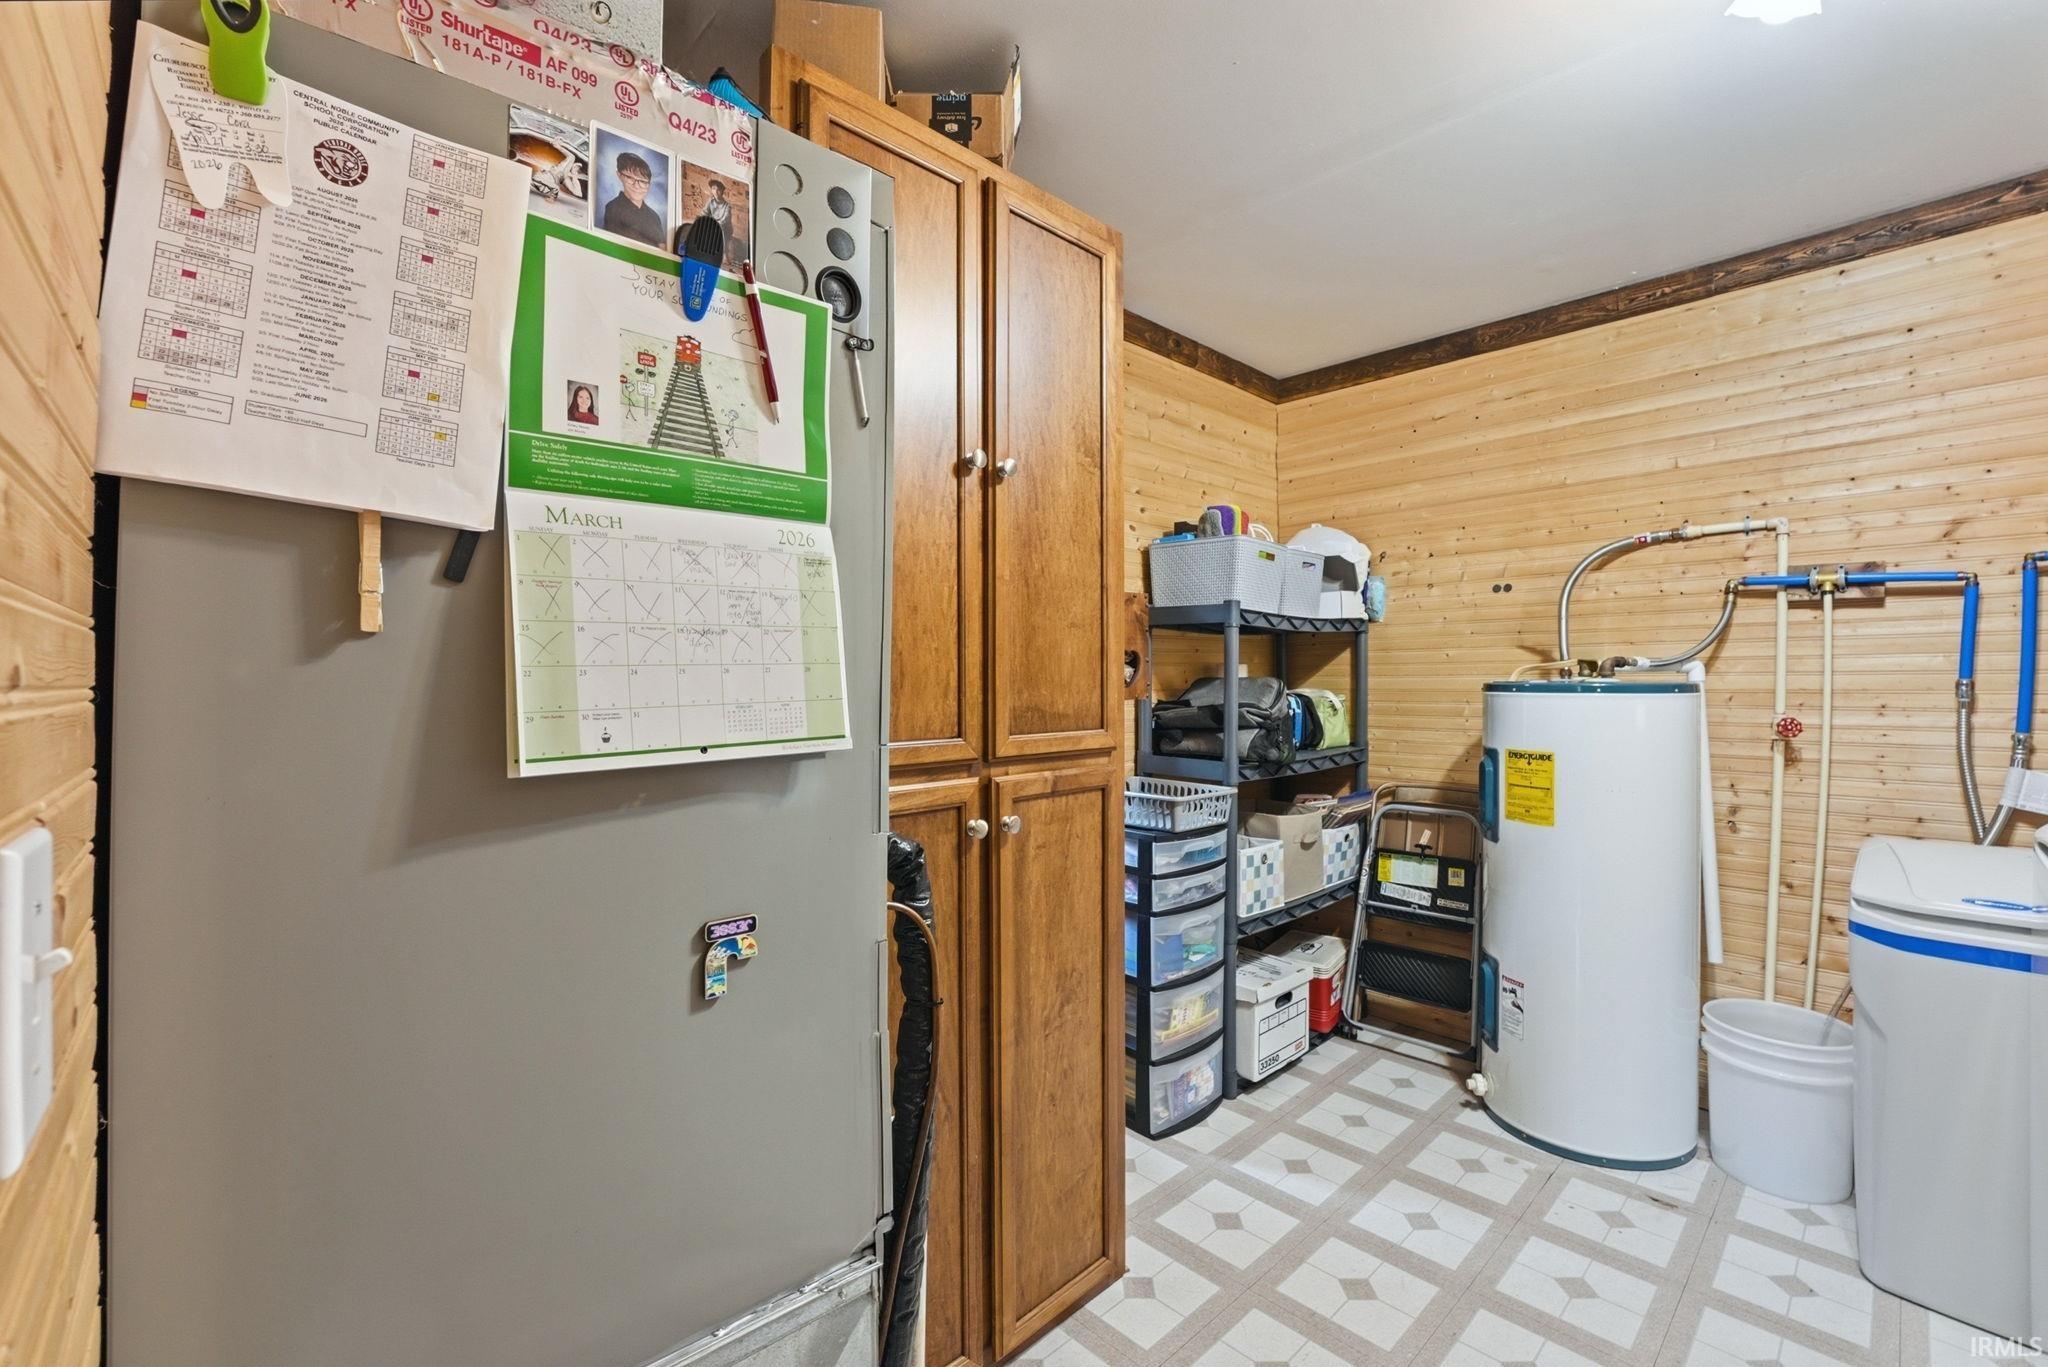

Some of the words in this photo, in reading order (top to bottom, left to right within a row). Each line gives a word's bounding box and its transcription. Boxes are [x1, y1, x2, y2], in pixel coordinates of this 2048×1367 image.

[401, 16, 432, 34] LISTED
[441, 11, 524, 56] Shurtape
[546, 57, 567, 73] AF
[572, 67, 597, 87] 099
[442, 35, 500, 65] 181A-P
[506, 61, 512, 70] /
[518, 65, 581, 99] 181B-FX
[621, 89, 633, 102] UL
[293, 90, 328, 108] CENTRAL
[330, 105, 355, 117] NOBLE
[357, 114, 399, 134] COMMUNITY
[615, 101, 638, 116] LISTED
[303, 101, 335, 117] SCHOOL
[336, 113, 389, 137] CORPORATION
[314, 118, 339, 131] PUBLIC
[340, 127, 377, 145] CALENDAR
[669, 112, 717, 144] Q4/23
[317, 187, 343, 198] AUGUST
[307, 210, 346, 225] SEPTEMBER
[307, 236, 338, 249] OCTOBER
[303, 255, 338, 268] NOVEMBER
[300, 274, 337, 288] DECEMBER
[338, 283, 352, 291] 2025
[645, 275, 675, 288] STAY
[632, 282, 664, 301] YOUR
[301, 294, 330, 306] JANUARY
[296, 312, 331, 325] FEBRUARY
[298, 333, 323, 343] MARCH
[299, 346, 318, 355] APRIL
[299, 366, 313, 374] MAY
[170, 387, 199, 396] LEGEND
[294, 392, 311, 400] JUNE
[545, 505, 623, 529] MARCH
[777, 529, 816, 548] 2026
[711, 919, 753, 938] JESSE
